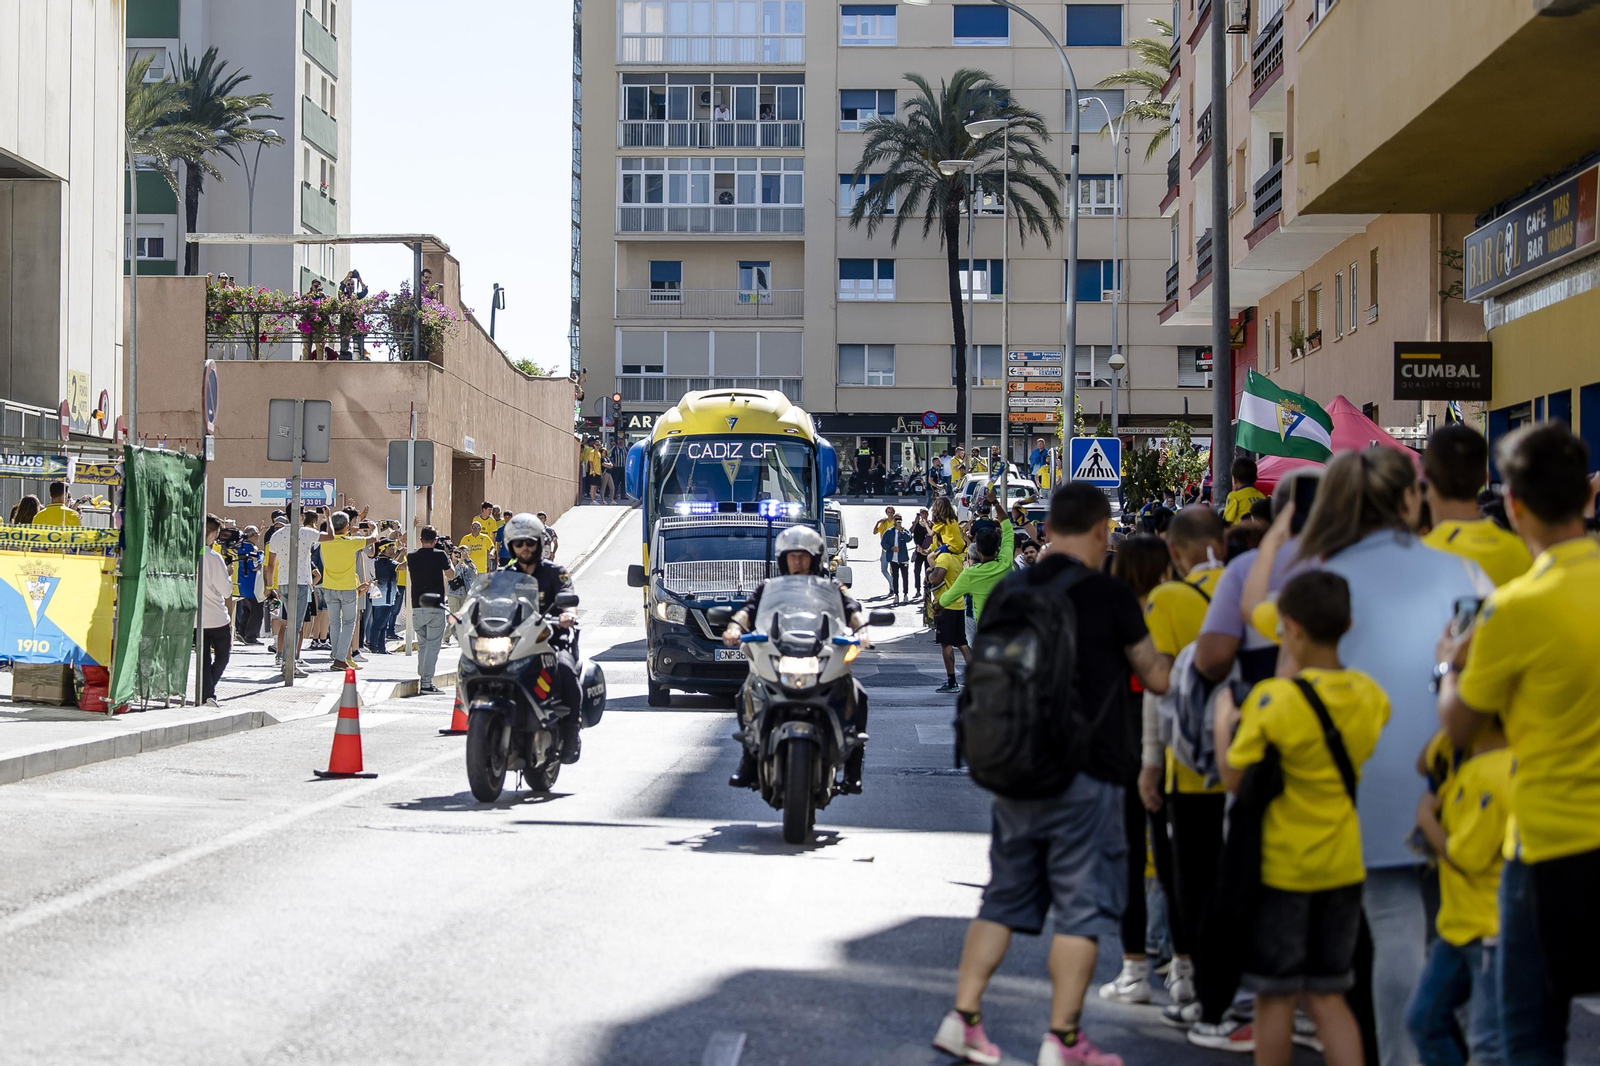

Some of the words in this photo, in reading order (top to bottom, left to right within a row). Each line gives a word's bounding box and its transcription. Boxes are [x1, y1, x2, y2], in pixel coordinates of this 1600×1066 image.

[1526, 203, 1547, 236] CAFÉ
[1527, 236, 1544, 262] BAR
[1468, 237, 1493, 290] BAR
[1401, 364, 1481, 378] CUMBAL
[71, 374, 77, 414] 2
[688, 443, 743, 459] CADIZ
[750, 443, 776, 458] CF
[7, 455, 43, 467] HIJOS
[260, 481, 322, 489] PODOCNTER
[234, 488, 248, 498] 50
[0, 529, 41, 542] ádiz
[47, 531, 89, 543] C.F.
[697, 595, 750, 603] POL
[17, 639, 50, 653] 1910
